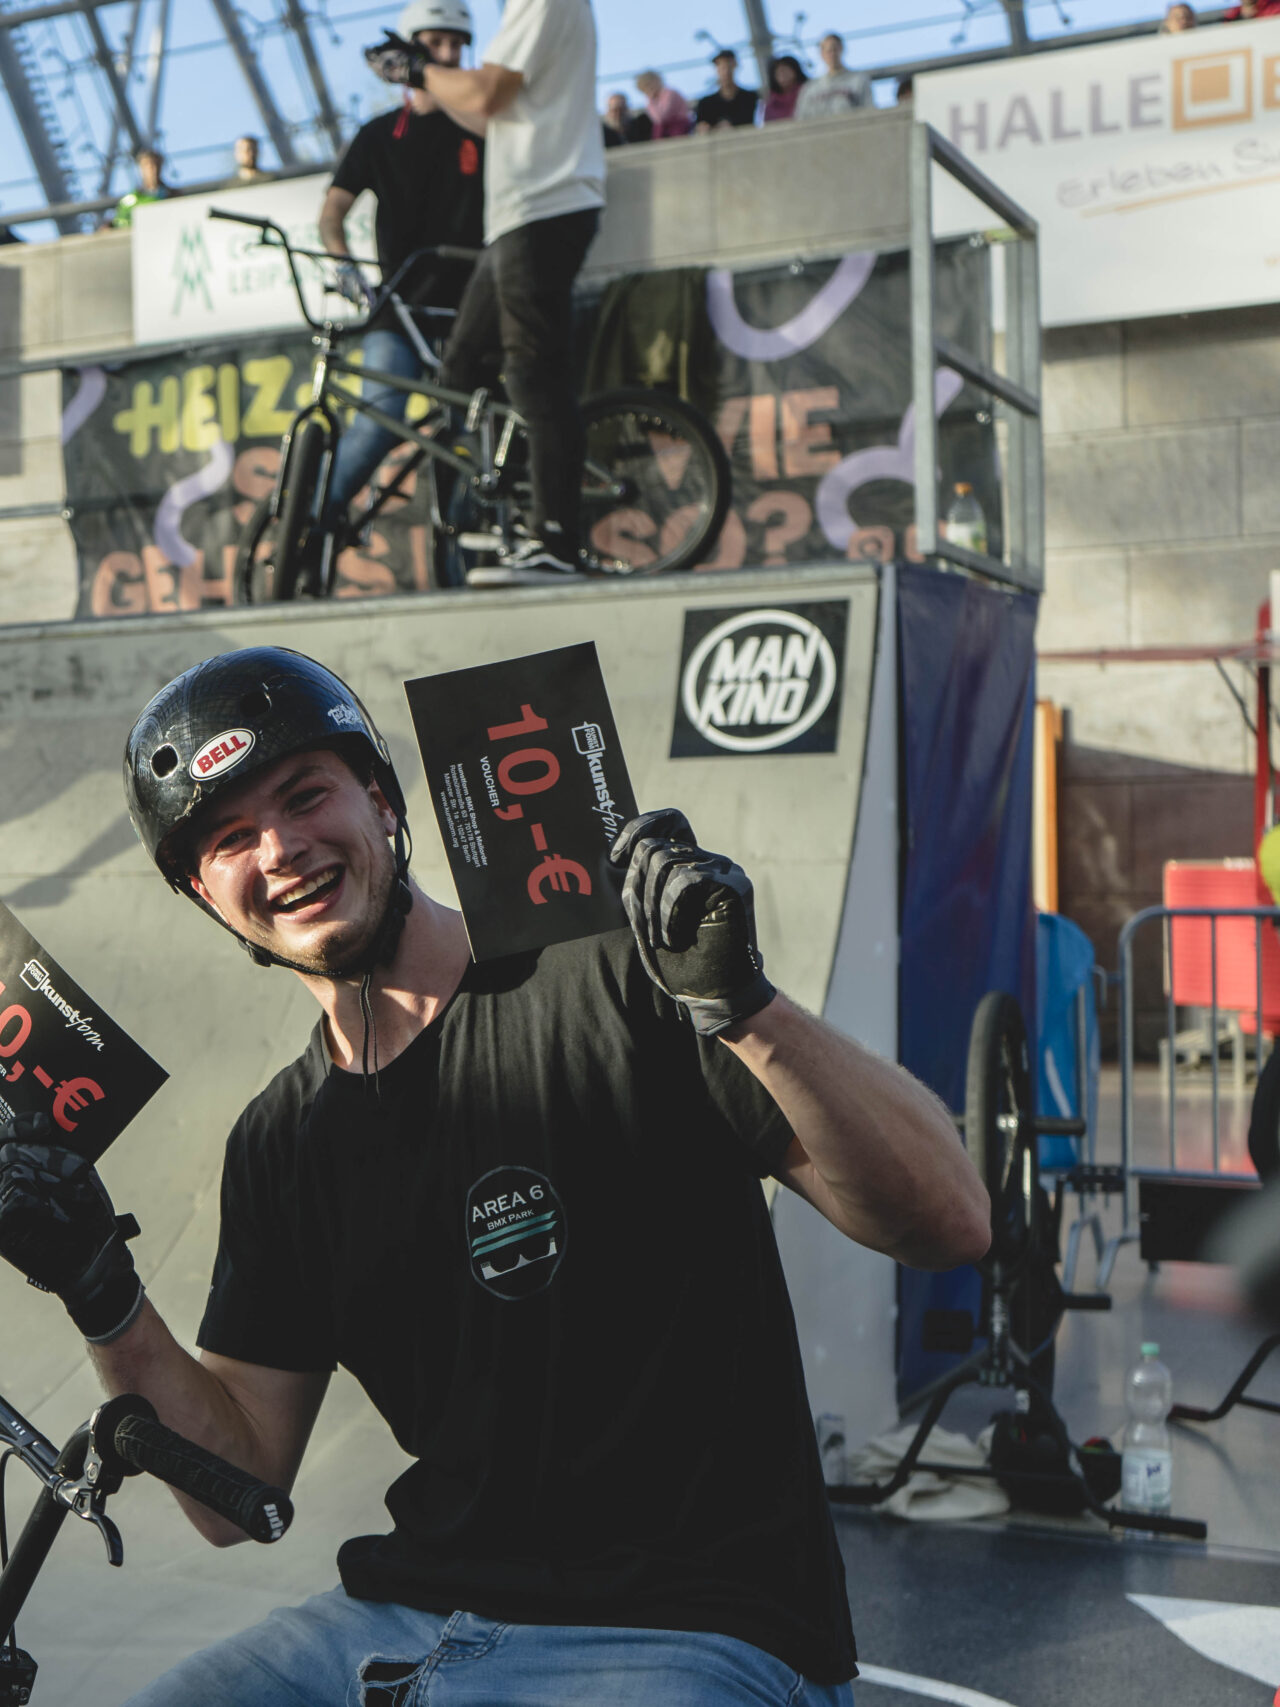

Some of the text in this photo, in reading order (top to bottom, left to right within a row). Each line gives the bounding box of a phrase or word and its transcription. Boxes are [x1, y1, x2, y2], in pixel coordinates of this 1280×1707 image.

[949, 72, 1165, 154] HALLE
[709, 627, 821, 681] MAN
[698, 679, 810, 728] KIND
[196, 735, 247, 774] BELL
[465, 796, 475, 812] BMX
[480, 755, 500, 808] VOUCHER
[586, 752, 625, 842] kunstfor
[469, 812, 478, 829] Shop
[40, 978, 105, 1052] kunstform
[472, 1184, 545, 1223] AREA 6
[486, 1208, 535, 1231] BMX PARK
